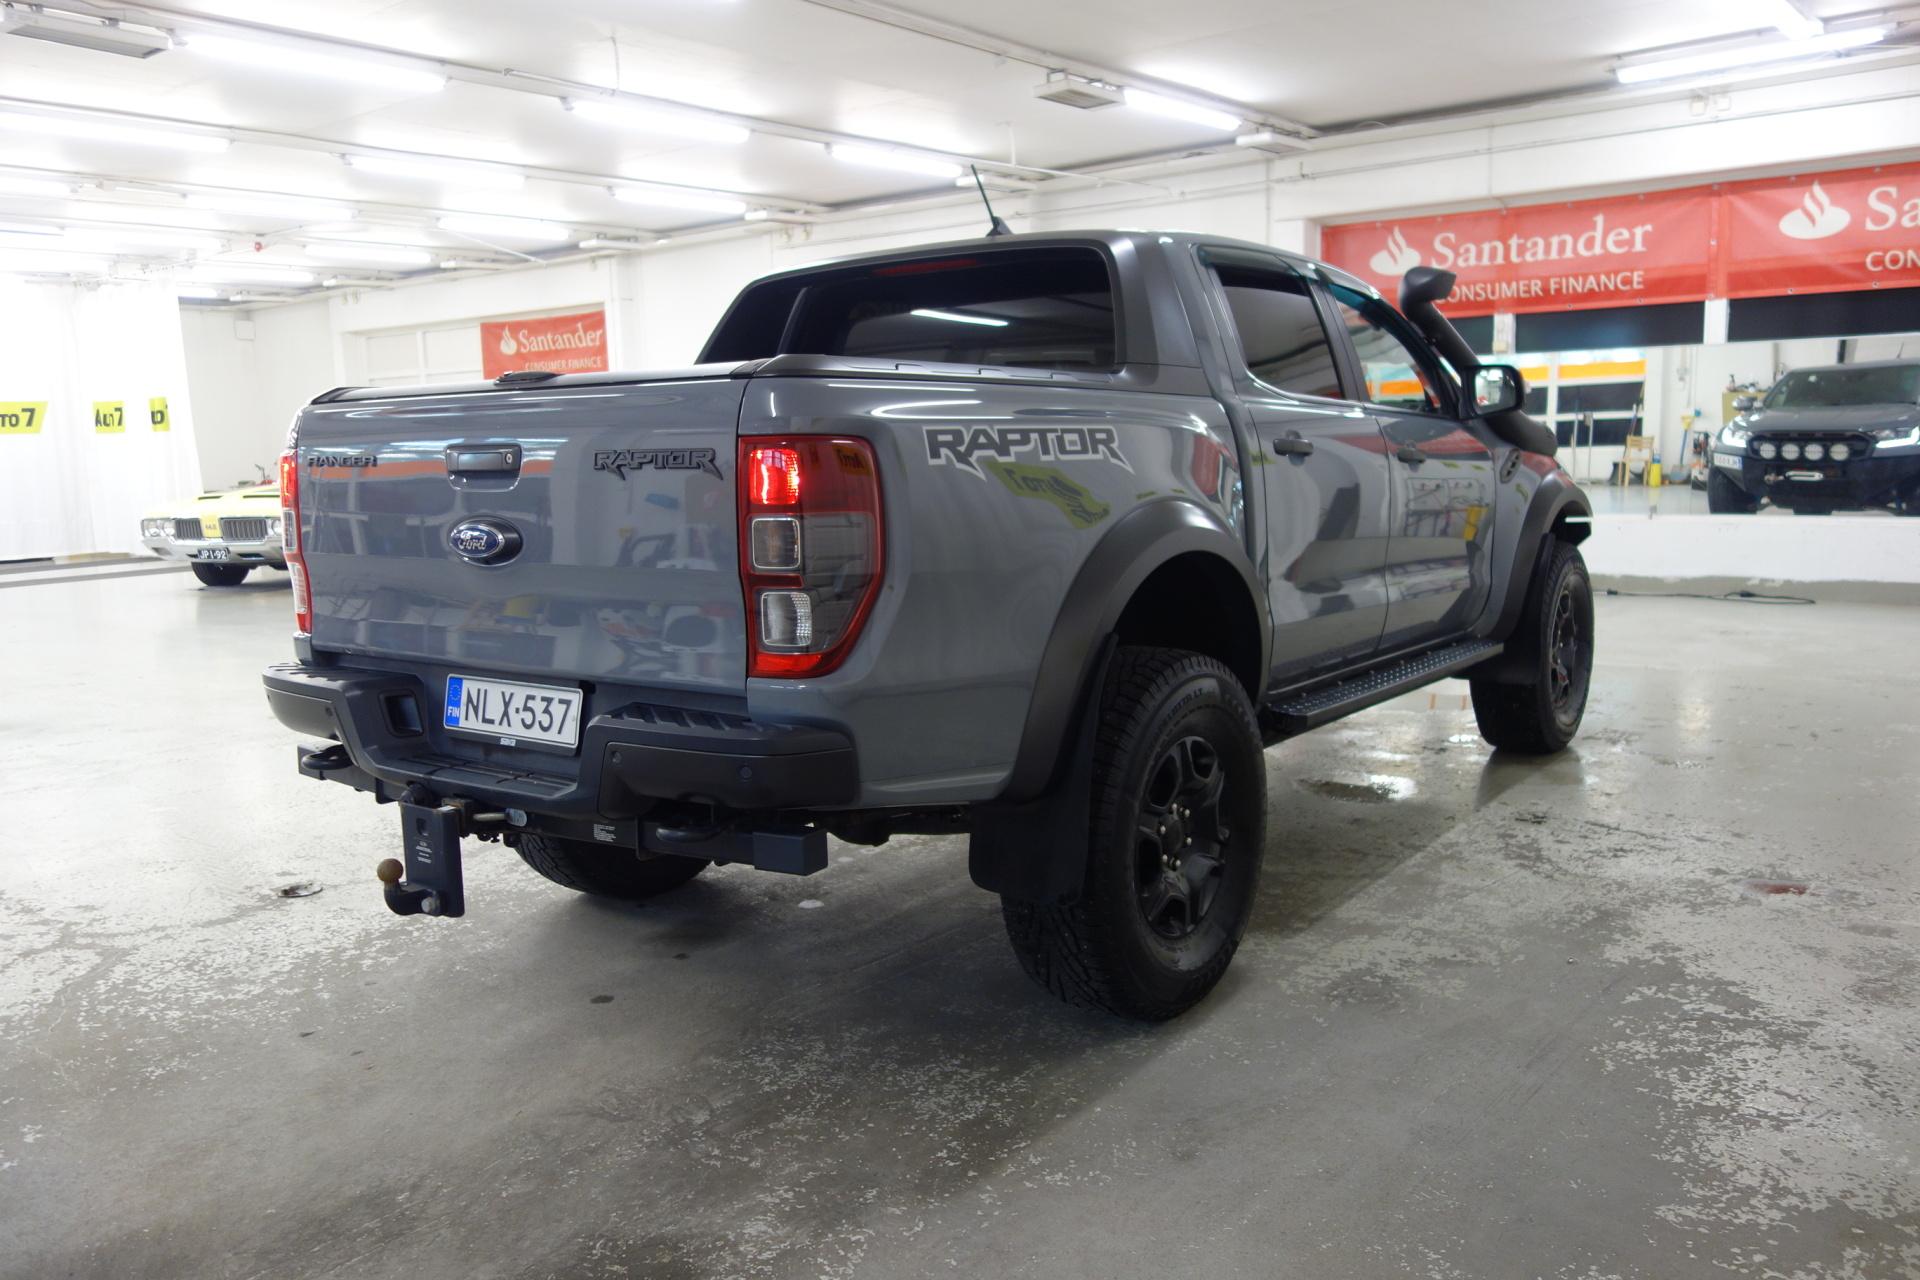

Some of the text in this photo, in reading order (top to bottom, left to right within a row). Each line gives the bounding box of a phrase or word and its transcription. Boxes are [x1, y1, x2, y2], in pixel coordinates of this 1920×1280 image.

[1431, 213, 1653, 269] Santander
[1437, 270, 1645, 304] ONSUMER FINANCE
[518, 321, 603, 354] Santander
[568, 356, 602, 369] FINANCE
[307, 455, 378, 467] RANGER
[593, 447, 723, 480] RAPTOR
[922, 425, 1136, 482] RAPTOR
[457, 530, 488, 551] Ford
[447, 706, 460, 719] FIN
[464, 687, 574, 736] NLX-537
